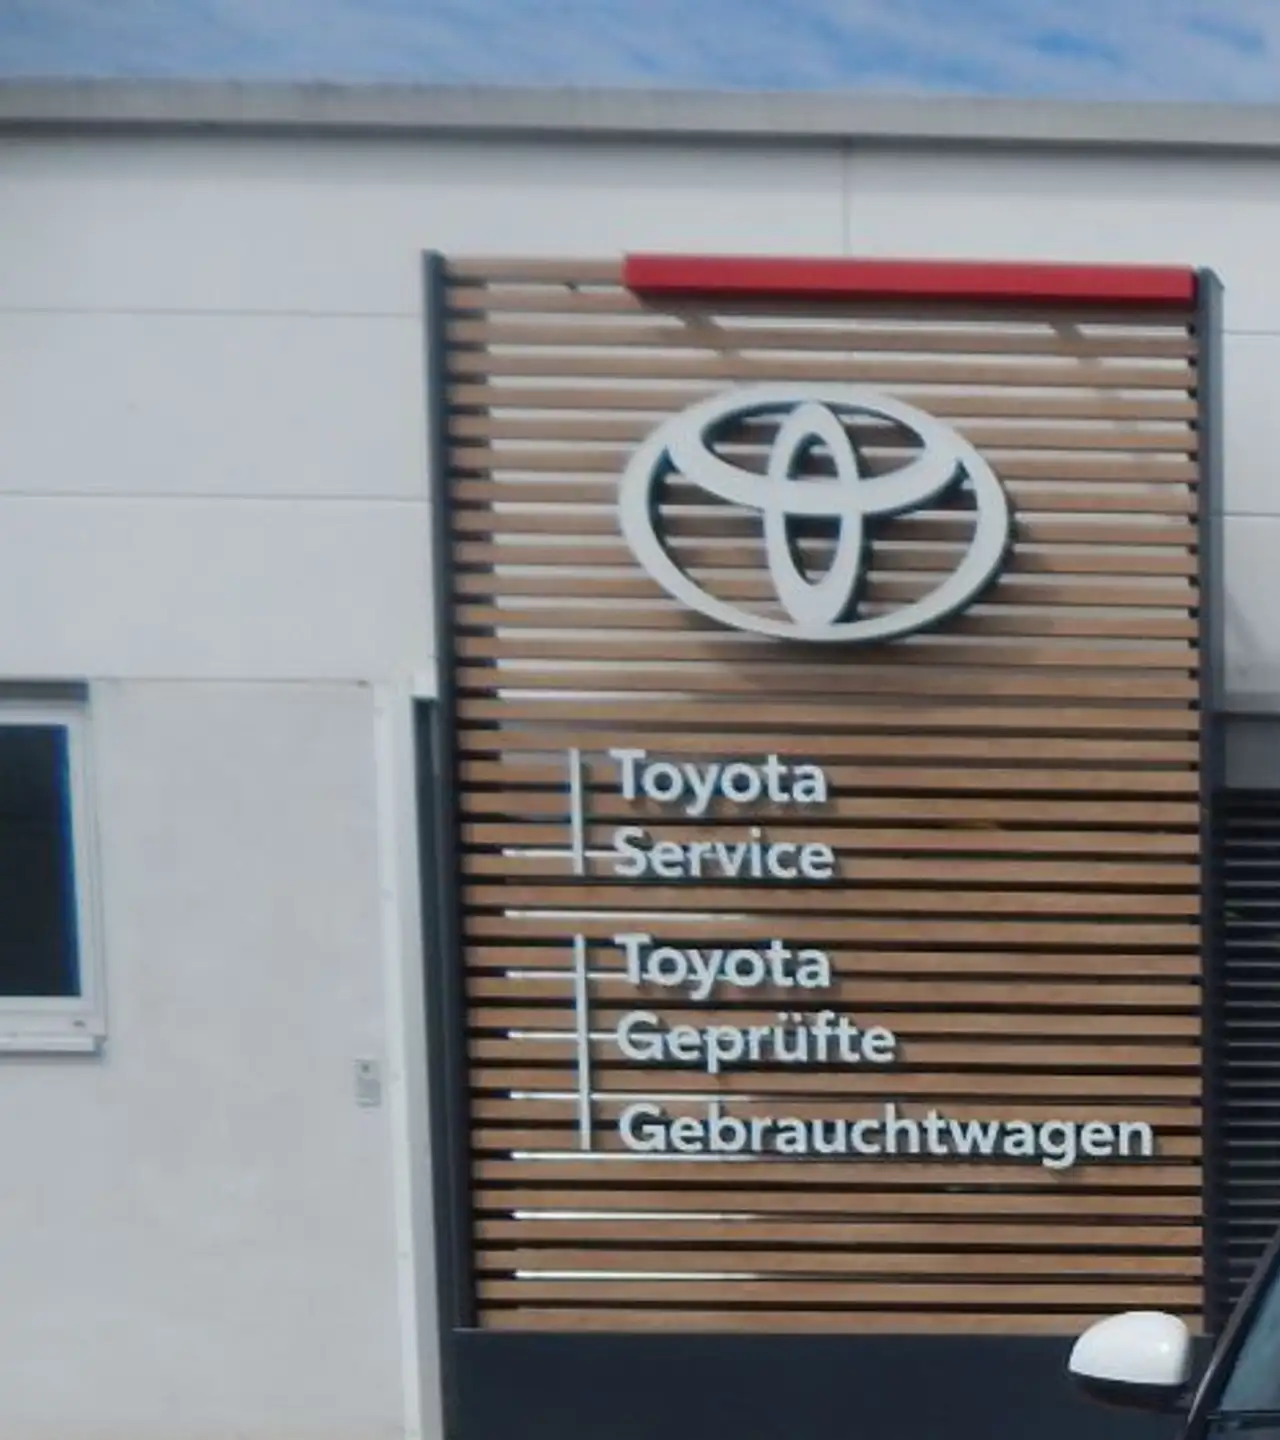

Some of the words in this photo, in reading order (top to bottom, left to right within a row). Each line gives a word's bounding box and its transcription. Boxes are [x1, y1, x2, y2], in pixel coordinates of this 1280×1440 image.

[609, 748, 829, 815] Toyota
[611, 827, 836, 880] Service
[614, 932, 832, 999] Toyota
[615, 1011, 898, 1073] Geprüfte
[617, 1103, 1155, 1168] Gebrauchtwagen
